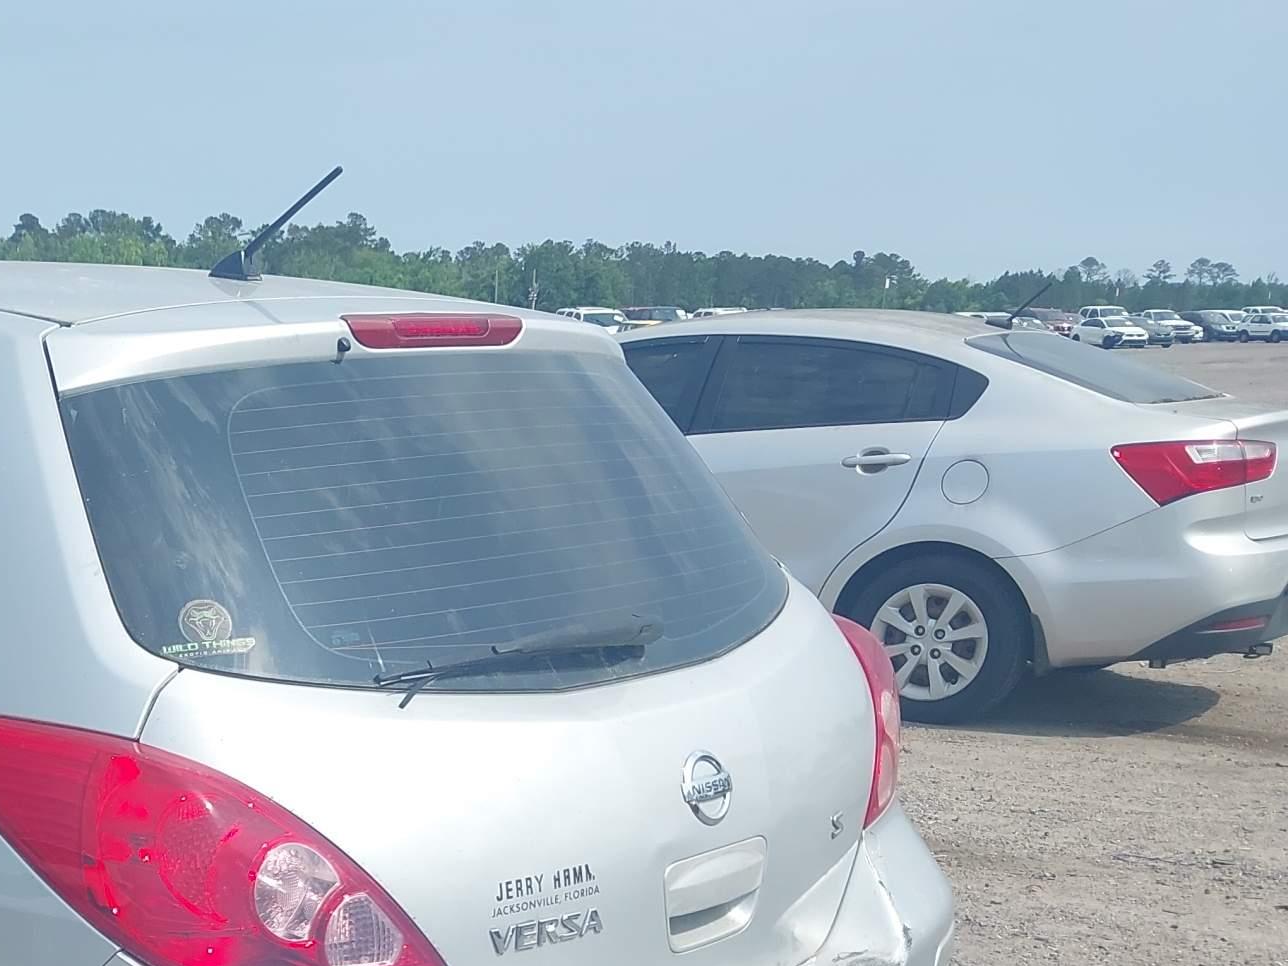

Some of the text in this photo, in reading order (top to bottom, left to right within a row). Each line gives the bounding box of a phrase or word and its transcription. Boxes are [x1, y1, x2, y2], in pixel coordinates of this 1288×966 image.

[691, 775, 730, 797] NISSAN
[830, 810, 844, 840] S
[490, 885, 600, 918] JACKSONVILLE, FLORIDA
[496, 873, 544, 902] JERRY
[488, 908, 603, 956] VERSA
